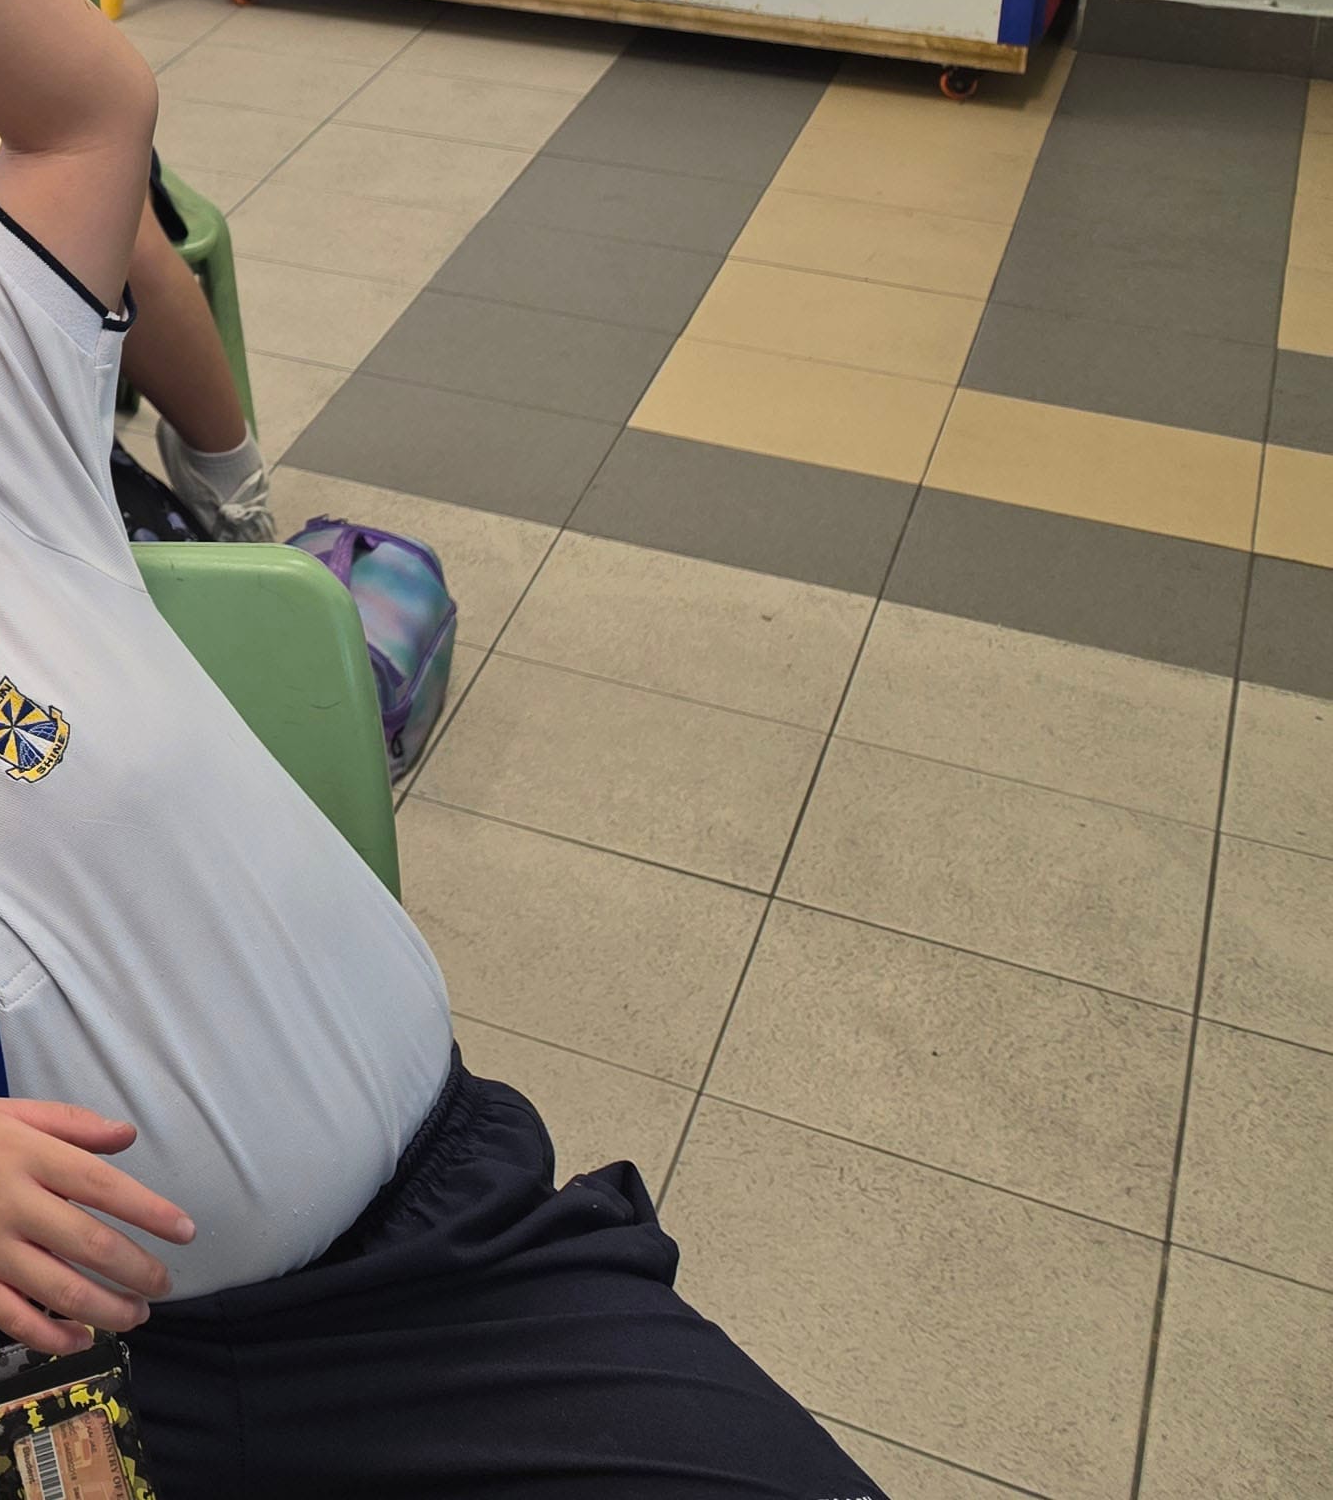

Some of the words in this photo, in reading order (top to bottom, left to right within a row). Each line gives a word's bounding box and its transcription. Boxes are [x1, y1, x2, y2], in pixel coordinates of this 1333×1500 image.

[36, 735, 66, 775] SHINE
[22, 1445, 37, 1485] Student
[101, 1420, 120, 1474] MINISTRY
[113, 1475, 124, 1490] OF
